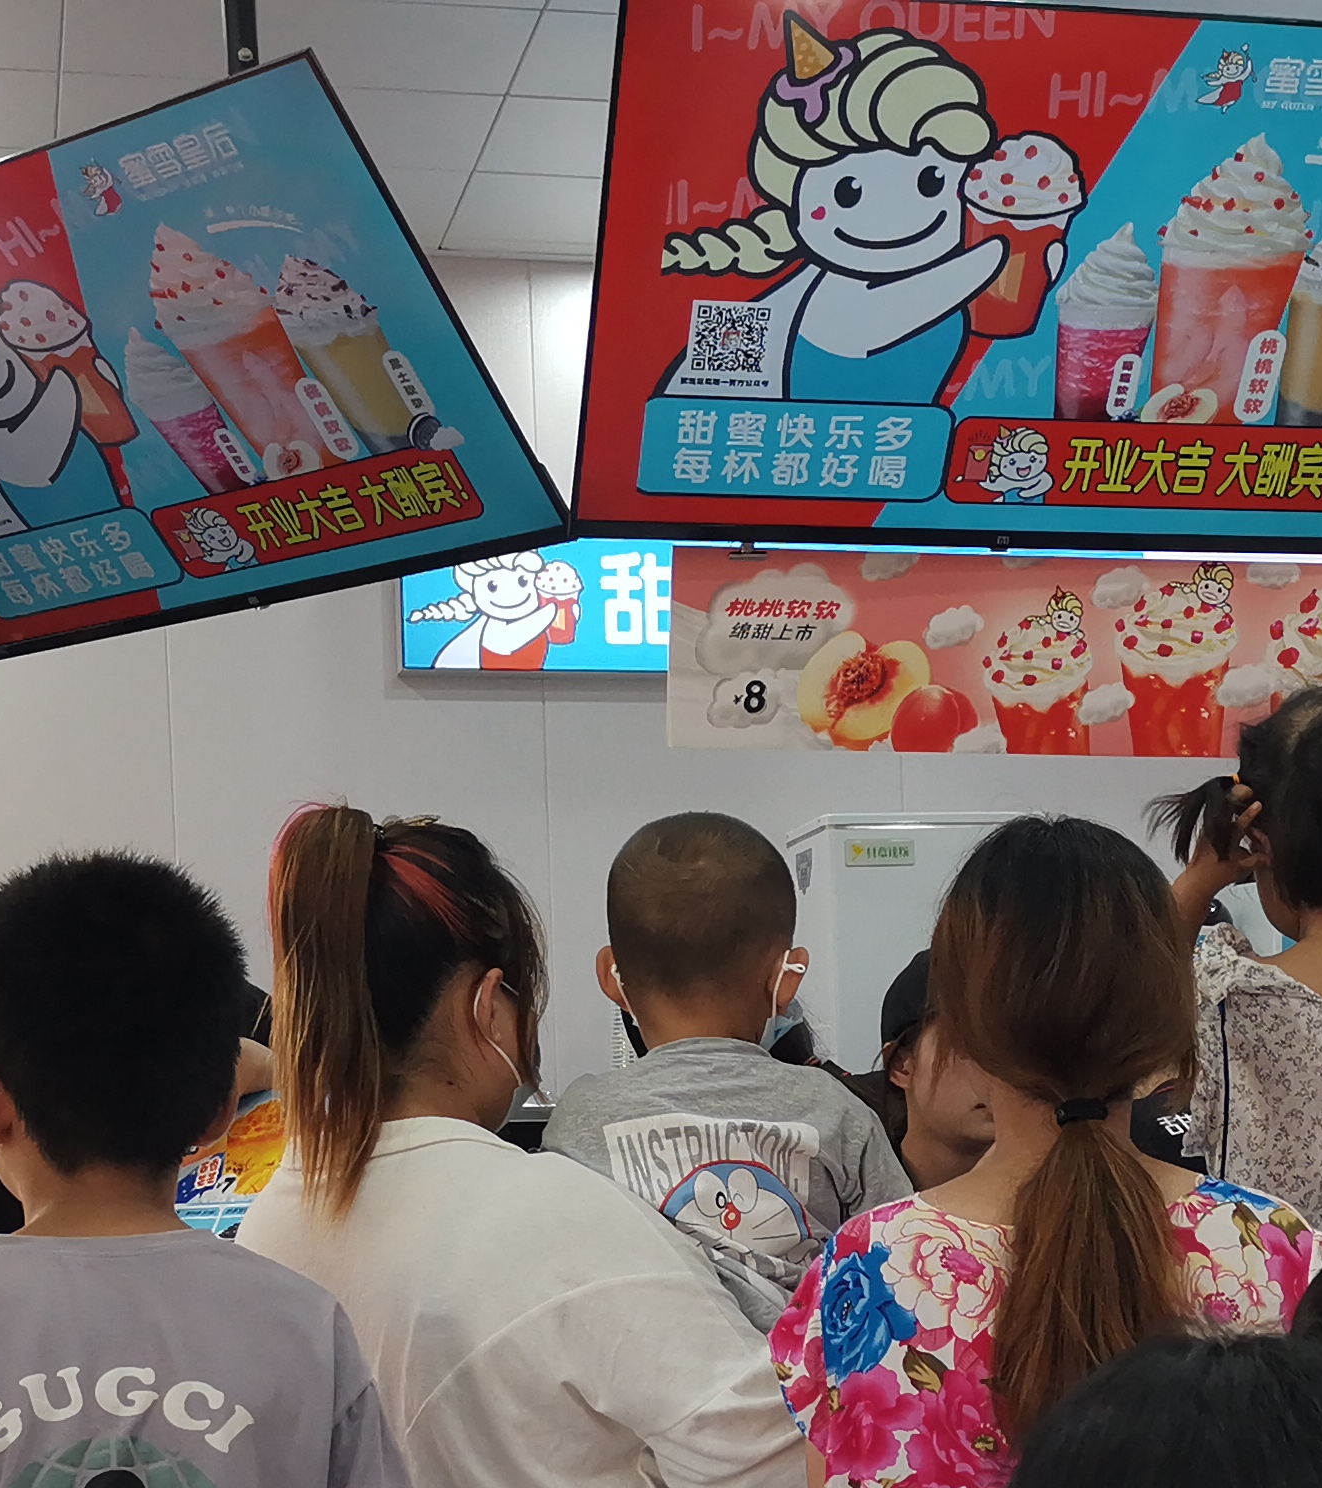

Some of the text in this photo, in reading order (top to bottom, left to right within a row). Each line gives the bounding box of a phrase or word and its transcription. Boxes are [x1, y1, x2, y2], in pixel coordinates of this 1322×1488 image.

[1243, 338, 1281, 415] 桃桃软软
[677, 410, 913, 452] 甜蜜快乐多
[672, 447, 908, 489] 每杯都好喝
[1062, 438, 1215, 494] 开业大吉
[236, 483, 367, 551] 开业大吉
[0, 551, 156, 606] 每杯都好喝
[600, 551, 670, 646] 甜
[724, 597, 842, 620] 桃桃软软
[728, 622, 818, 643] 绵甜上市
